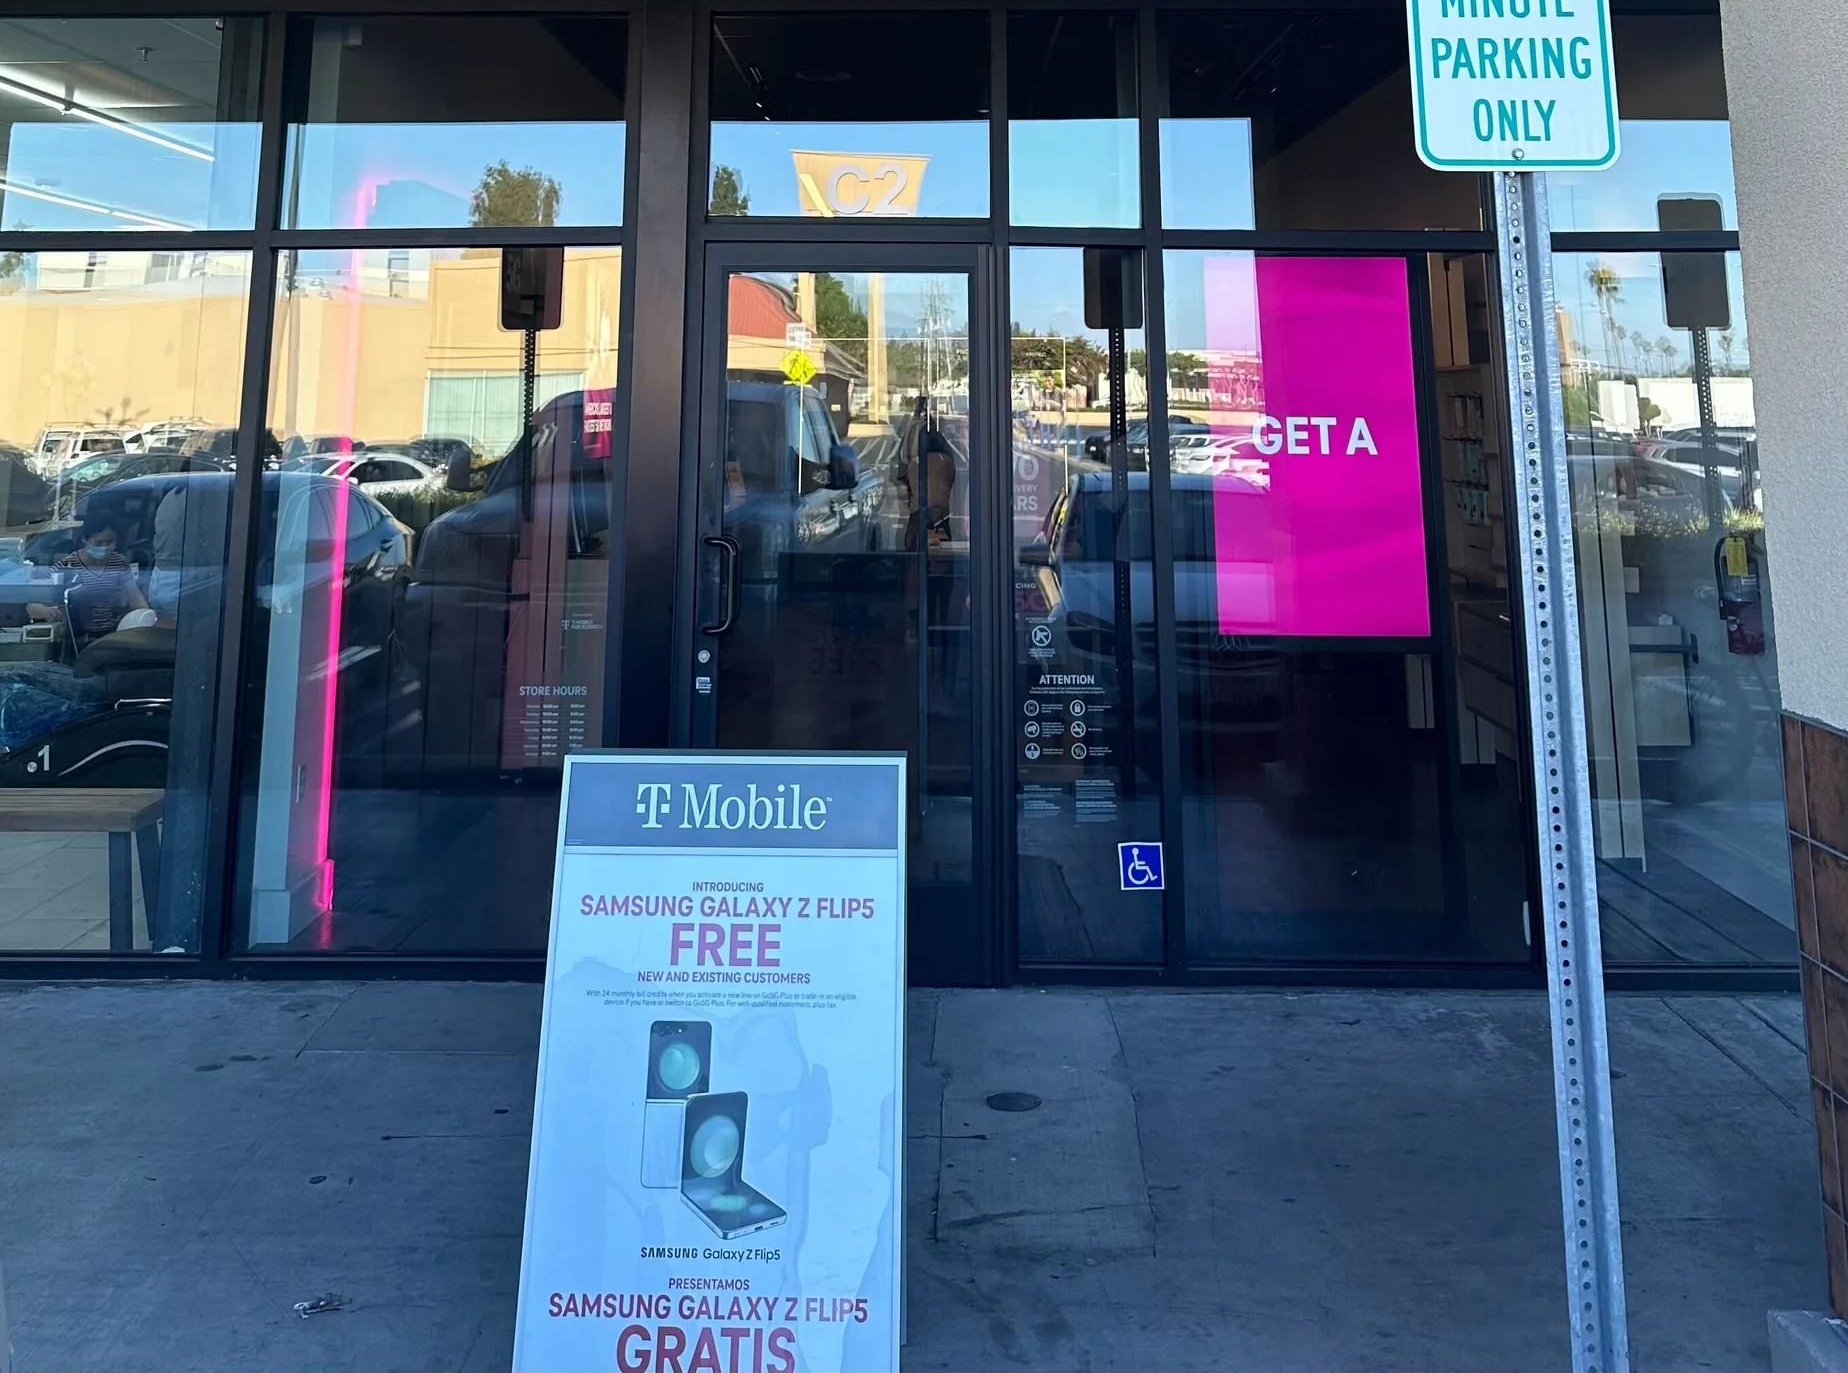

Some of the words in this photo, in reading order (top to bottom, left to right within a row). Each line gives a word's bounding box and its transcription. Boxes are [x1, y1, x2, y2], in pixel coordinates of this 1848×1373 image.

[1431, 37, 1592, 79] PARKING
[1473, 99, 1556, 142] ONLY
[826, 162, 908, 215] C2
[1252, 416, 1337, 455] GET
[1346, 417, 1378, 455] A
[519, 686, 550, 696] STORE
[552, 686, 588, 696] HOURS
[1039, 674, 1095, 685] ATTENTION
[678, 784, 827, 830] Mobile
[692, 881, 764, 893] INTRODUCING
[580, 894, 694, 917] SAMSUNG
[700, 896, 792, 918] GALAXY
[797, 898, 810, 918] Z
[816, 898, 875, 919] FLIP5
[669, 922, 782, 967] FREE
[637, 971, 664, 982] NEW
[665, 971, 689, 982] AND
[692, 972, 741, 983] EXISTING
[744, 972, 811, 984] CUSTOMERS
[586, 989, 601, 997] With
[611, 990, 635, 998] monthly
[834, 993, 857, 1001] eligible
[640, 1247, 698, 1259] SAMSUNG
[703, 1247, 744, 1262] Galaxy
[746, 1249, 754, 1259] Z
[755, 1248, 780, 1263] Flip5
[668, 1278, 750, 1290] PRESENTAMOS
[548, 1292, 671, 1318] SAMSUNG
[678, 1295, 779, 1321] GALAXY
[784, 1298, 798, 1320] Z
[805, 1298, 868, 1323] FLIP5
[616, 1324, 797, 1373] GRATIS
